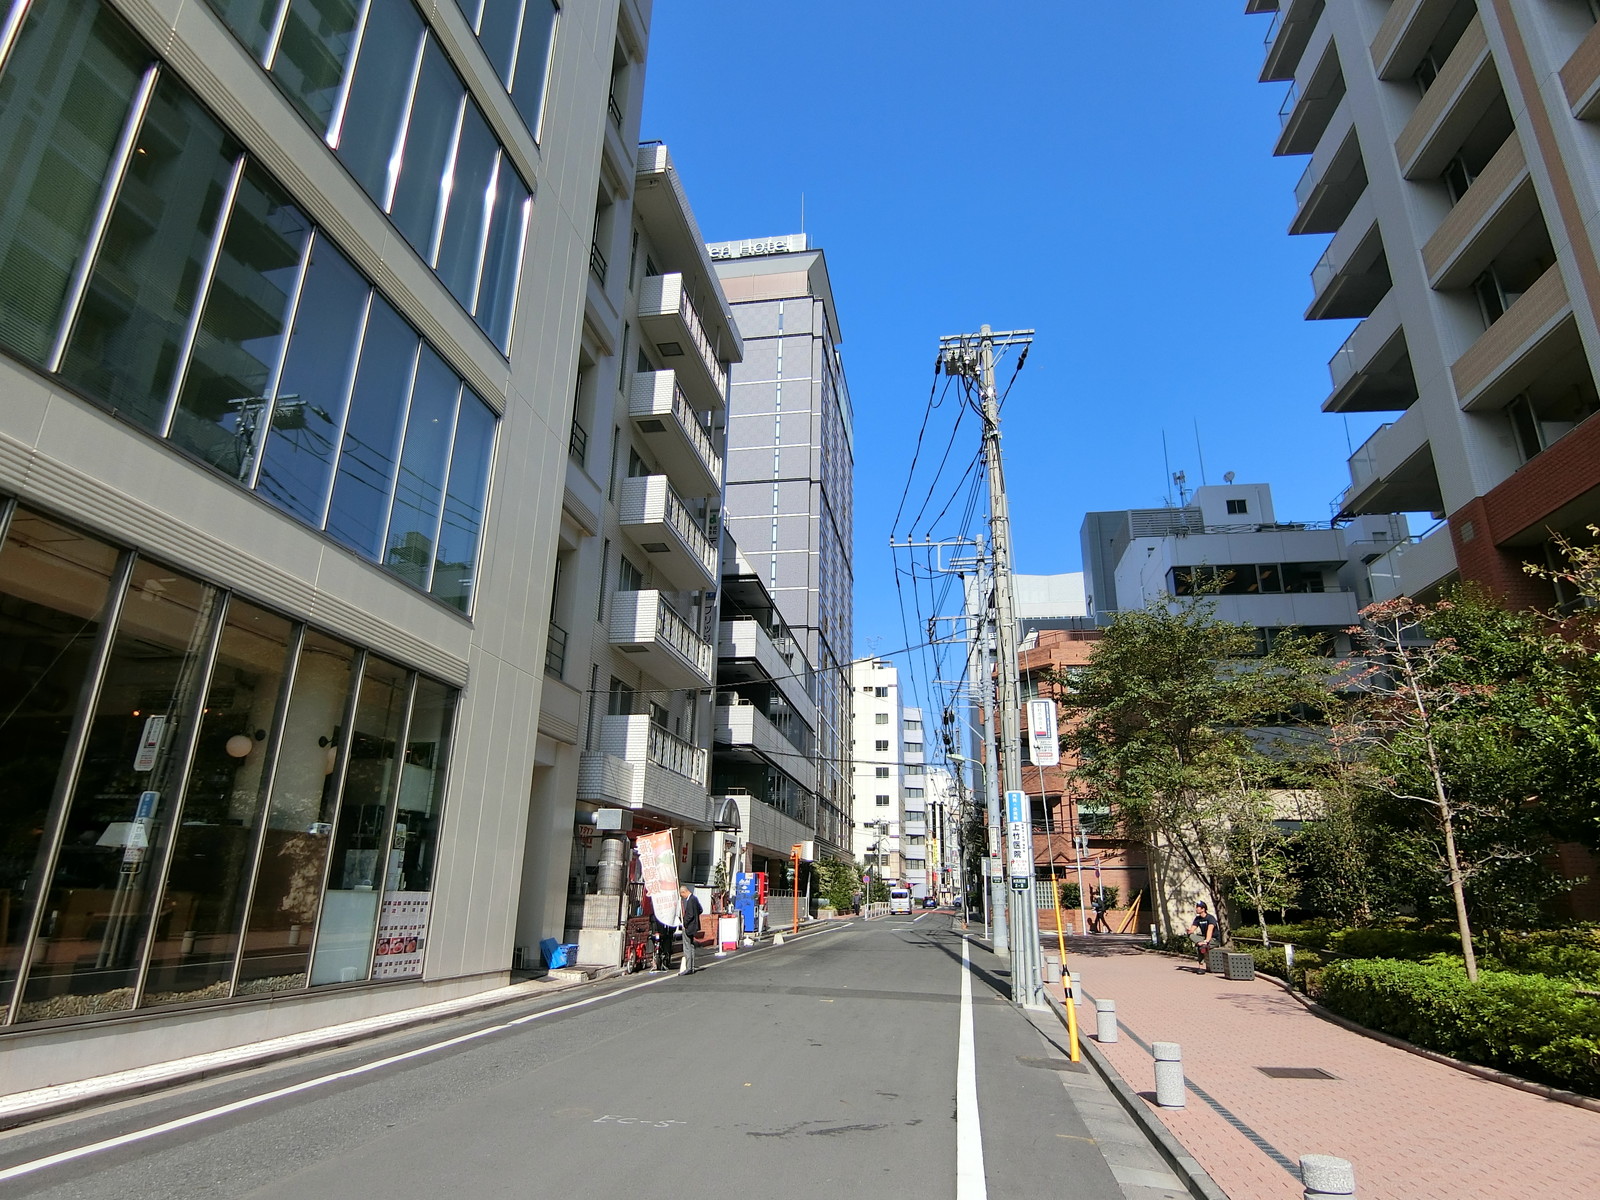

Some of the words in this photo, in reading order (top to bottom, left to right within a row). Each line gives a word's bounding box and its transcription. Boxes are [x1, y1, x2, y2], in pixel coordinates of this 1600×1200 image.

[739, 235, 789, 257] Hotel
[1012, 823, 1022, 859] 上竹医院
